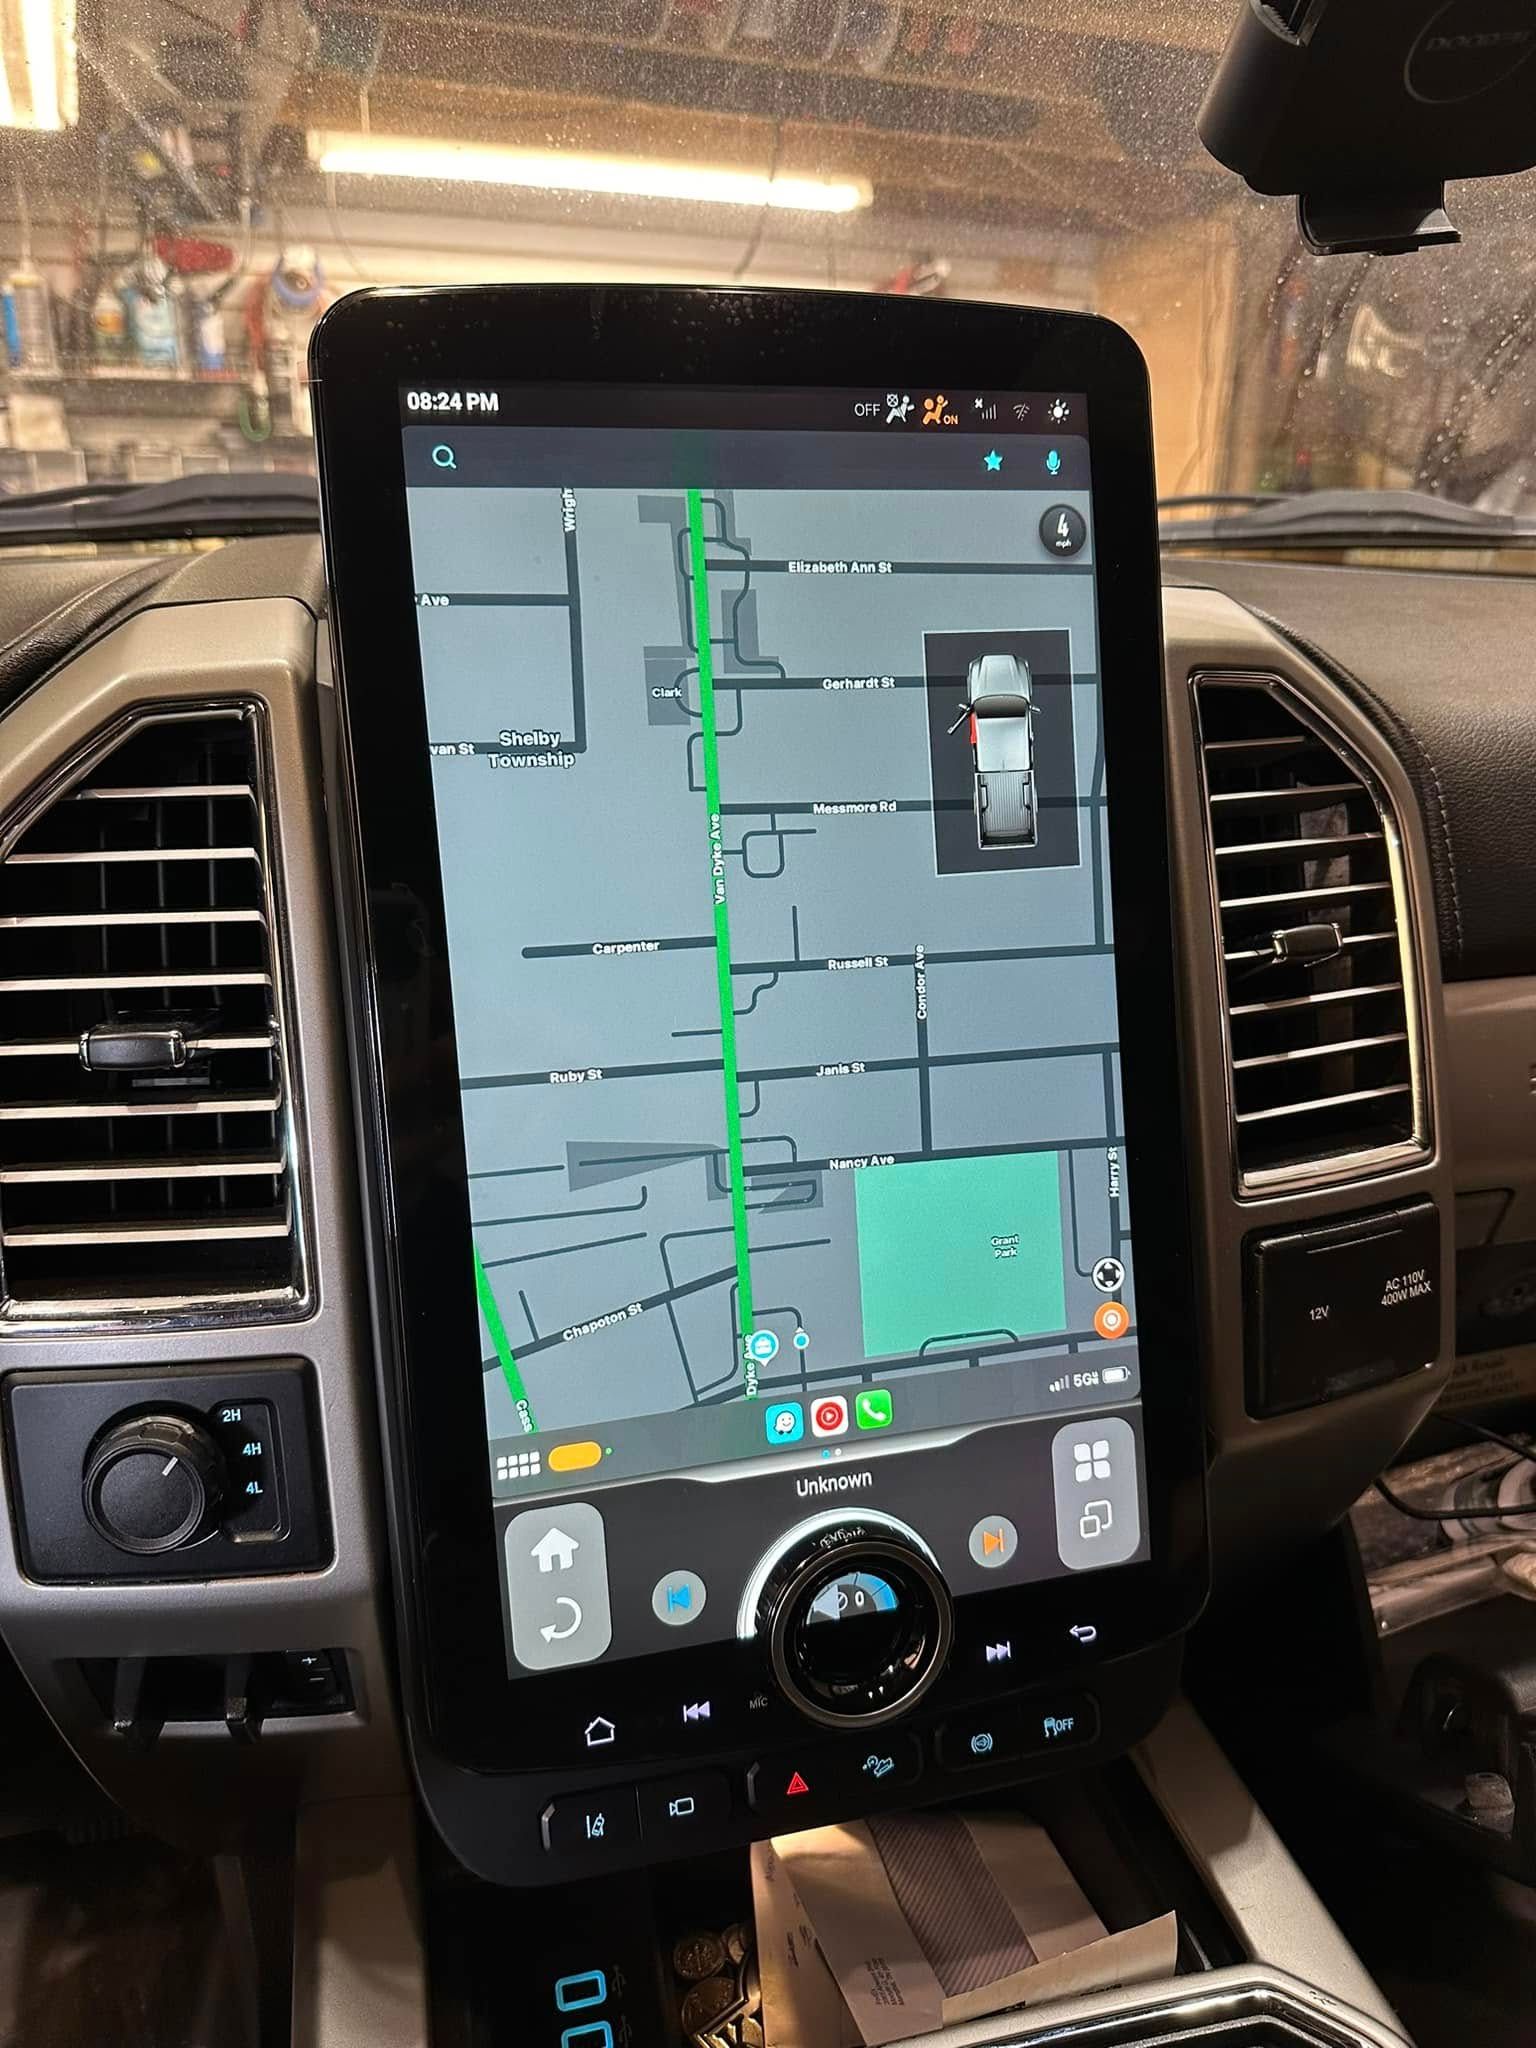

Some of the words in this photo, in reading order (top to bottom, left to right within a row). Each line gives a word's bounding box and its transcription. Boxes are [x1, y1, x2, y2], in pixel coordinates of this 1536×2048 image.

[407, 392, 462, 411] 08:24
[466, 392, 499, 412] PM
[854, 402, 881, 418] OFF
[943, 414, 959, 425] ON
[562, 487, 577, 532] Wrigh
[1056, 512, 1070, 538] 4
[1055, 538, 1072, 549] mph
[788, 561, 847, 575] Elizabeth
[850, 561, 876, 573] Ann
[878, 561, 892, 573] St
[421, 593, 450, 607] Ave
[822, 678, 879, 690] Gerhardt
[880, 677, 896, 688] St
[652, 686, 683, 698] Clark
[499, 731, 561, 748] Shelby
[430, 745, 456, 755] van
[458, 743, 475, 755] St
[488, 751, 576, 769] Township
[813, 802, 877, 816] Messmore
[879, 801, 897, 813] Rd
[710, 813, 721, 840] Ave
[712, 842, 724, 877] Dyke
[714, 879, 726, 905] Van
[592, 940, 661, 956] Carpenter
[828, 957, 873, 971] Russell
[874, 956, 889, 968] St
[914, 944, 926, 971] Ave
[915, 971, 928, 1021] Condor
[549, 1070, 585, 1084] Ruby
[587, 1068, 603, 1081] St
[816, 1063, 850, 1077] Janis
[851, 1062, 866, 1074] St
[1107, 1146, 1118, 1161] St
[829, 1156, 868, 1171] Nancy
[870, 1155, 895, 1167] Ave
[1109, 1162, 1120, 1198] Harry
[990, 1234, 1020, 1246] Grant
[994, 1247, 1018, 1258] Park
[1385, 1277, 1401, 1292] AC
[1401, 1269, 1426, 1287] 110V
[1380, 1289, 1409, 1306] 400W
[1409, 1280, 1432, 1297] MAX
[1309, 1305, 1330, 1321] 12V
[562, 1310, 627, 1341] Chapoton
[627, 1302, 643, 1316] St
[746, 1362, 759, 1396] Dyke
[222, 1408, 242, 1422] 2H
[516, 1399, 533, 1433] Cass
[243, 1442, 262, 1456] 4H
[246, 1481, 264, 1495] 4L
[796, 1470, 873, 1497] Unknown
[854, 1590, 866, 1608] 0
[749, 1697, 768, 1711] MIC
[1056, 1716, 1075, 1731] OFF
